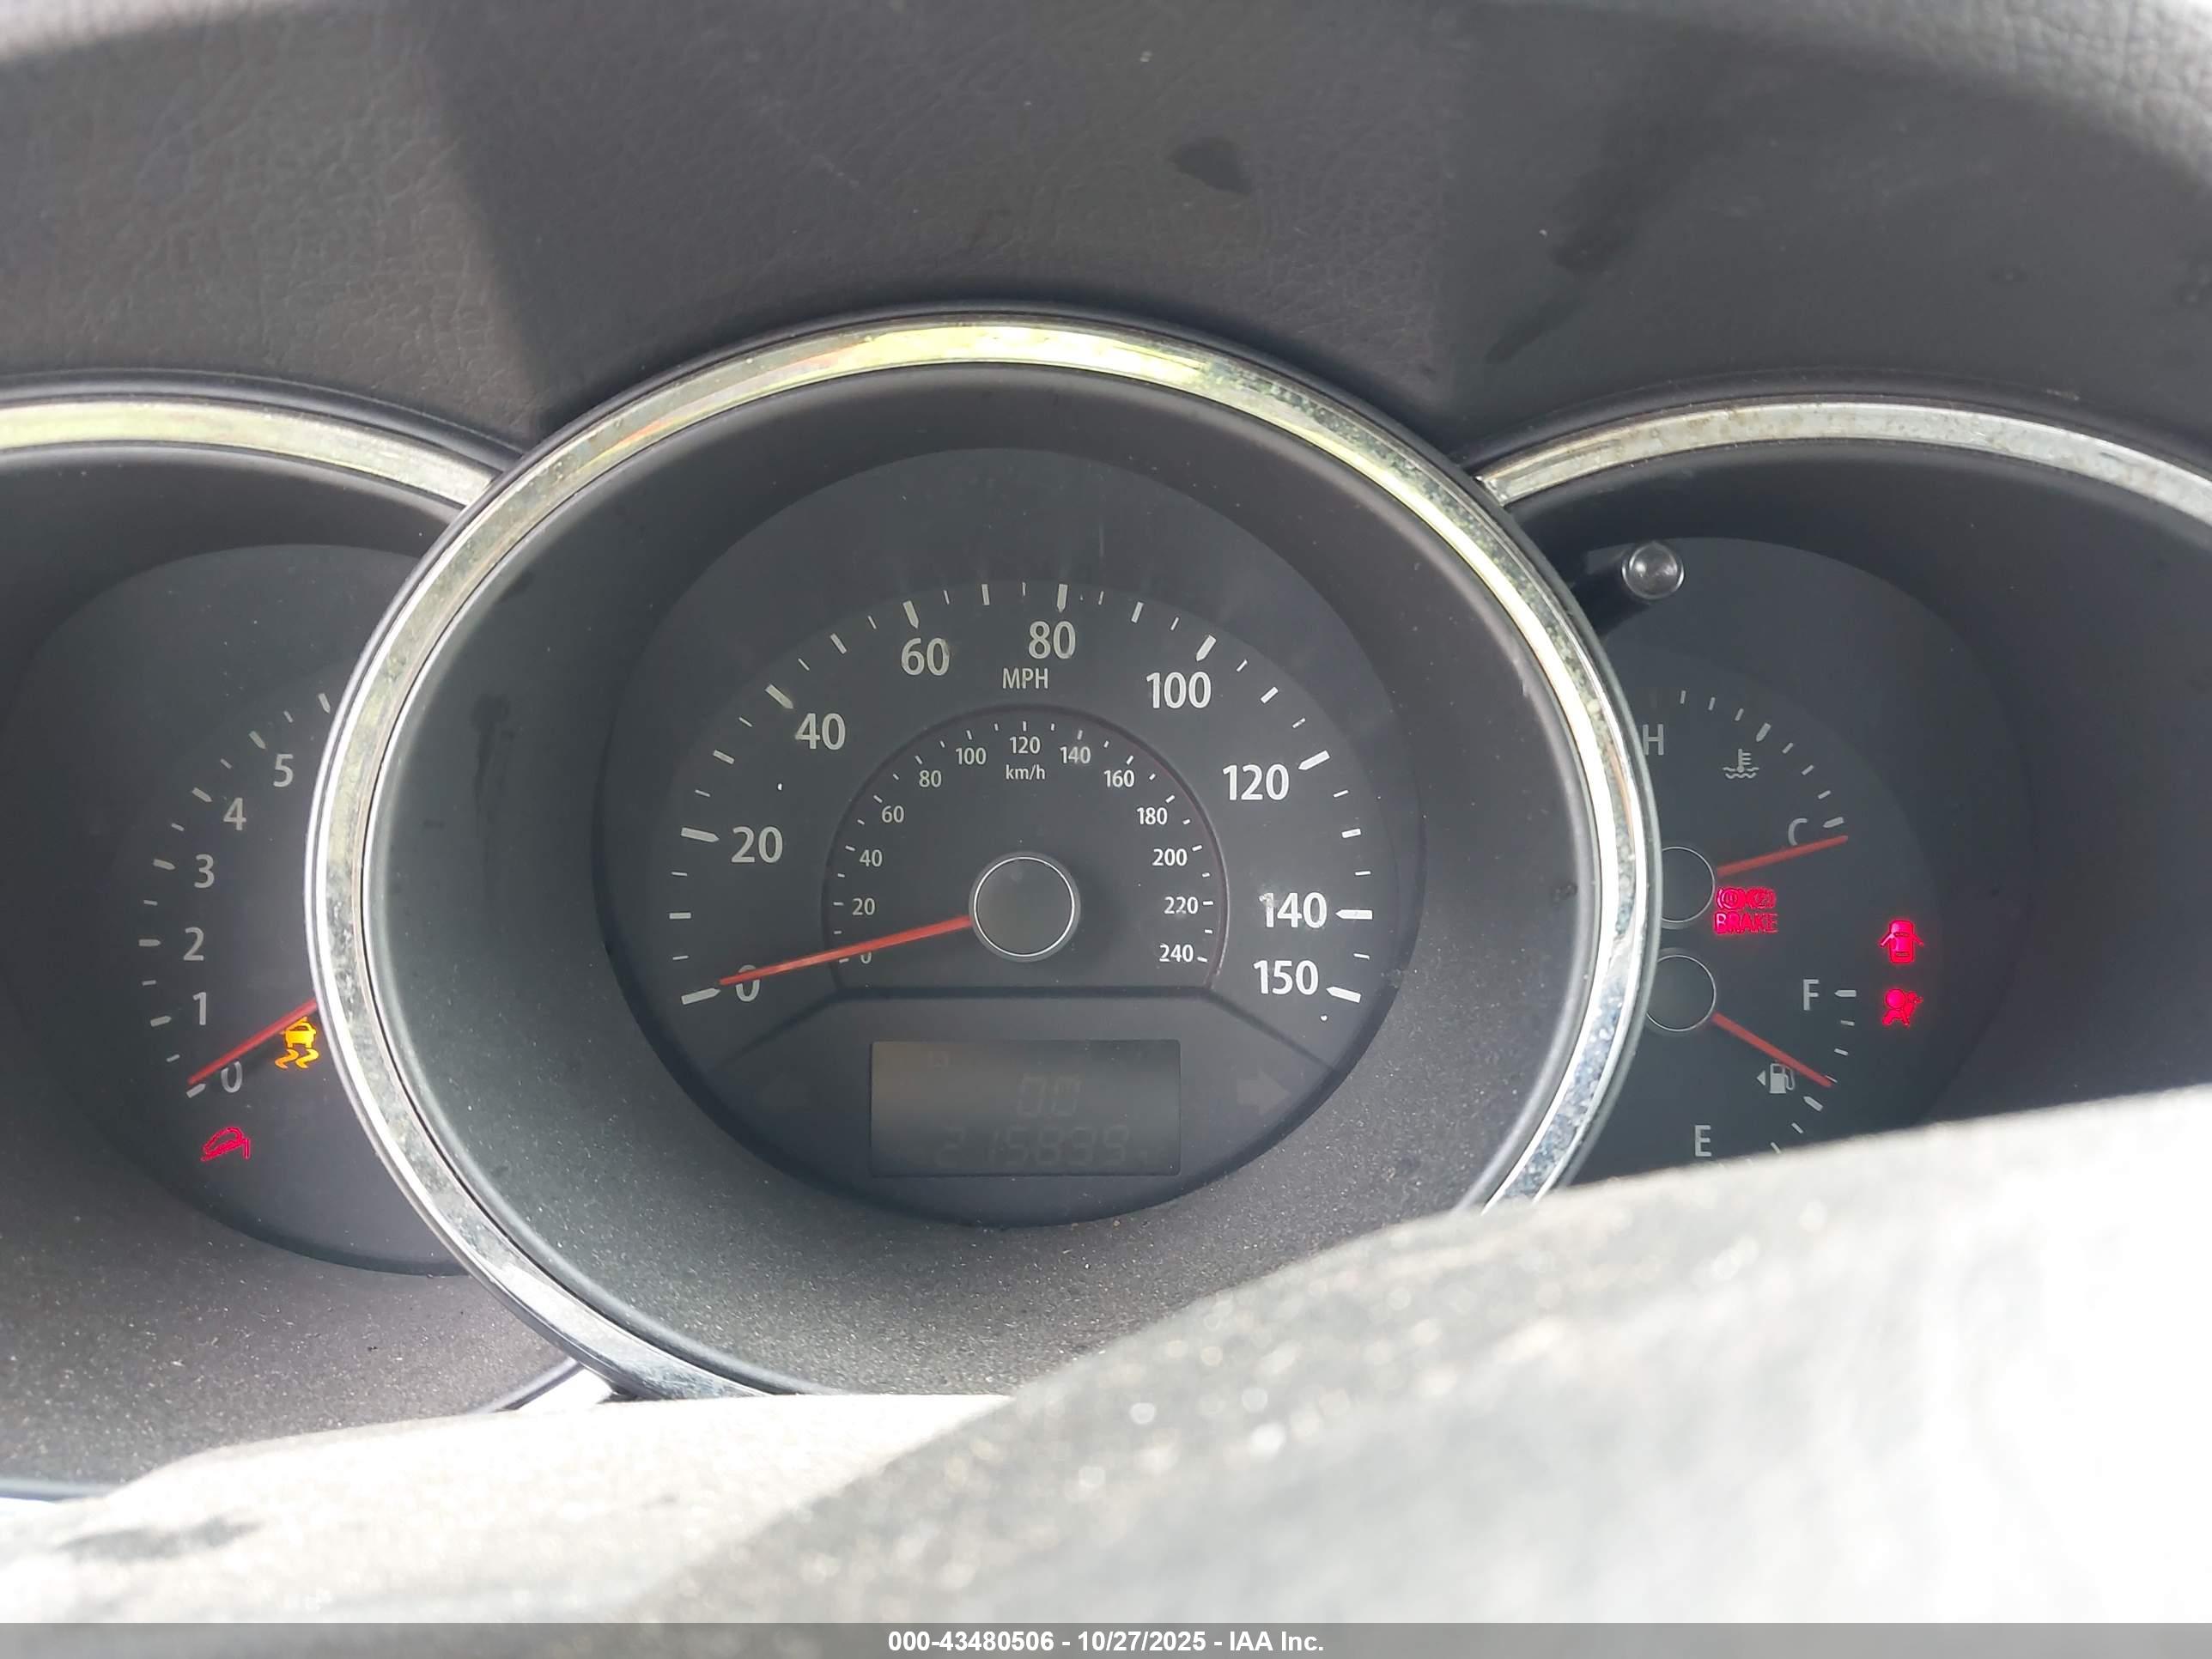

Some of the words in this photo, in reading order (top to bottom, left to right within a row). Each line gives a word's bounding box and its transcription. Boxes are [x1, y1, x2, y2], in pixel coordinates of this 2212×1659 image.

[1028, 621, 1075, 659] 80
[900, 638, 950, 676] 60
[1002, 667, 1048, 690] MPH
[1146, 672, 1211, 709] 100
[795, 713, 845, 750] 40
[1009, 736, 1041, 754] 120
[1643, 724, 1665, 756] H
[274, 753, 293, 787] 5
[956, 748, 986, 765] 100
[1060, 746, 1091, 764] 140
[919, 770, 941, 787] 80
[1006, 763, 1046, 781] km/h
[1104, 770, 1134, 787] 160
[1223, 763, 1289, 800] 120
[223, 798, 246, 830] 4
[881, 806, 904, 823] 60
[1137, 808, 1167, 824] 180
[732, 827, 782, 863] 20
[859, 850, 882, 866] 40
[1152, 849, 1187, 866] 200
[194, 854, 214, 889] 3
[852, 898, 875, 915] 20
[1164, 897, 1198, 915] 220
[1260, 892, 1326, 928] 140
[1716, 913, 1778, 933] BRAKE
[183, 927, 204, 962] 2
[1159, 945, 1194, 962] 240
[735, 965, 760, 1002] 0
[1254, 960, 1317, 995] 150
[192, 992, 207, 1025] 1
[1803, 979, 1820, 1011] F
[222, 1061, 243, 1092] 0
[1694, 1125, 1711, 1158] E
